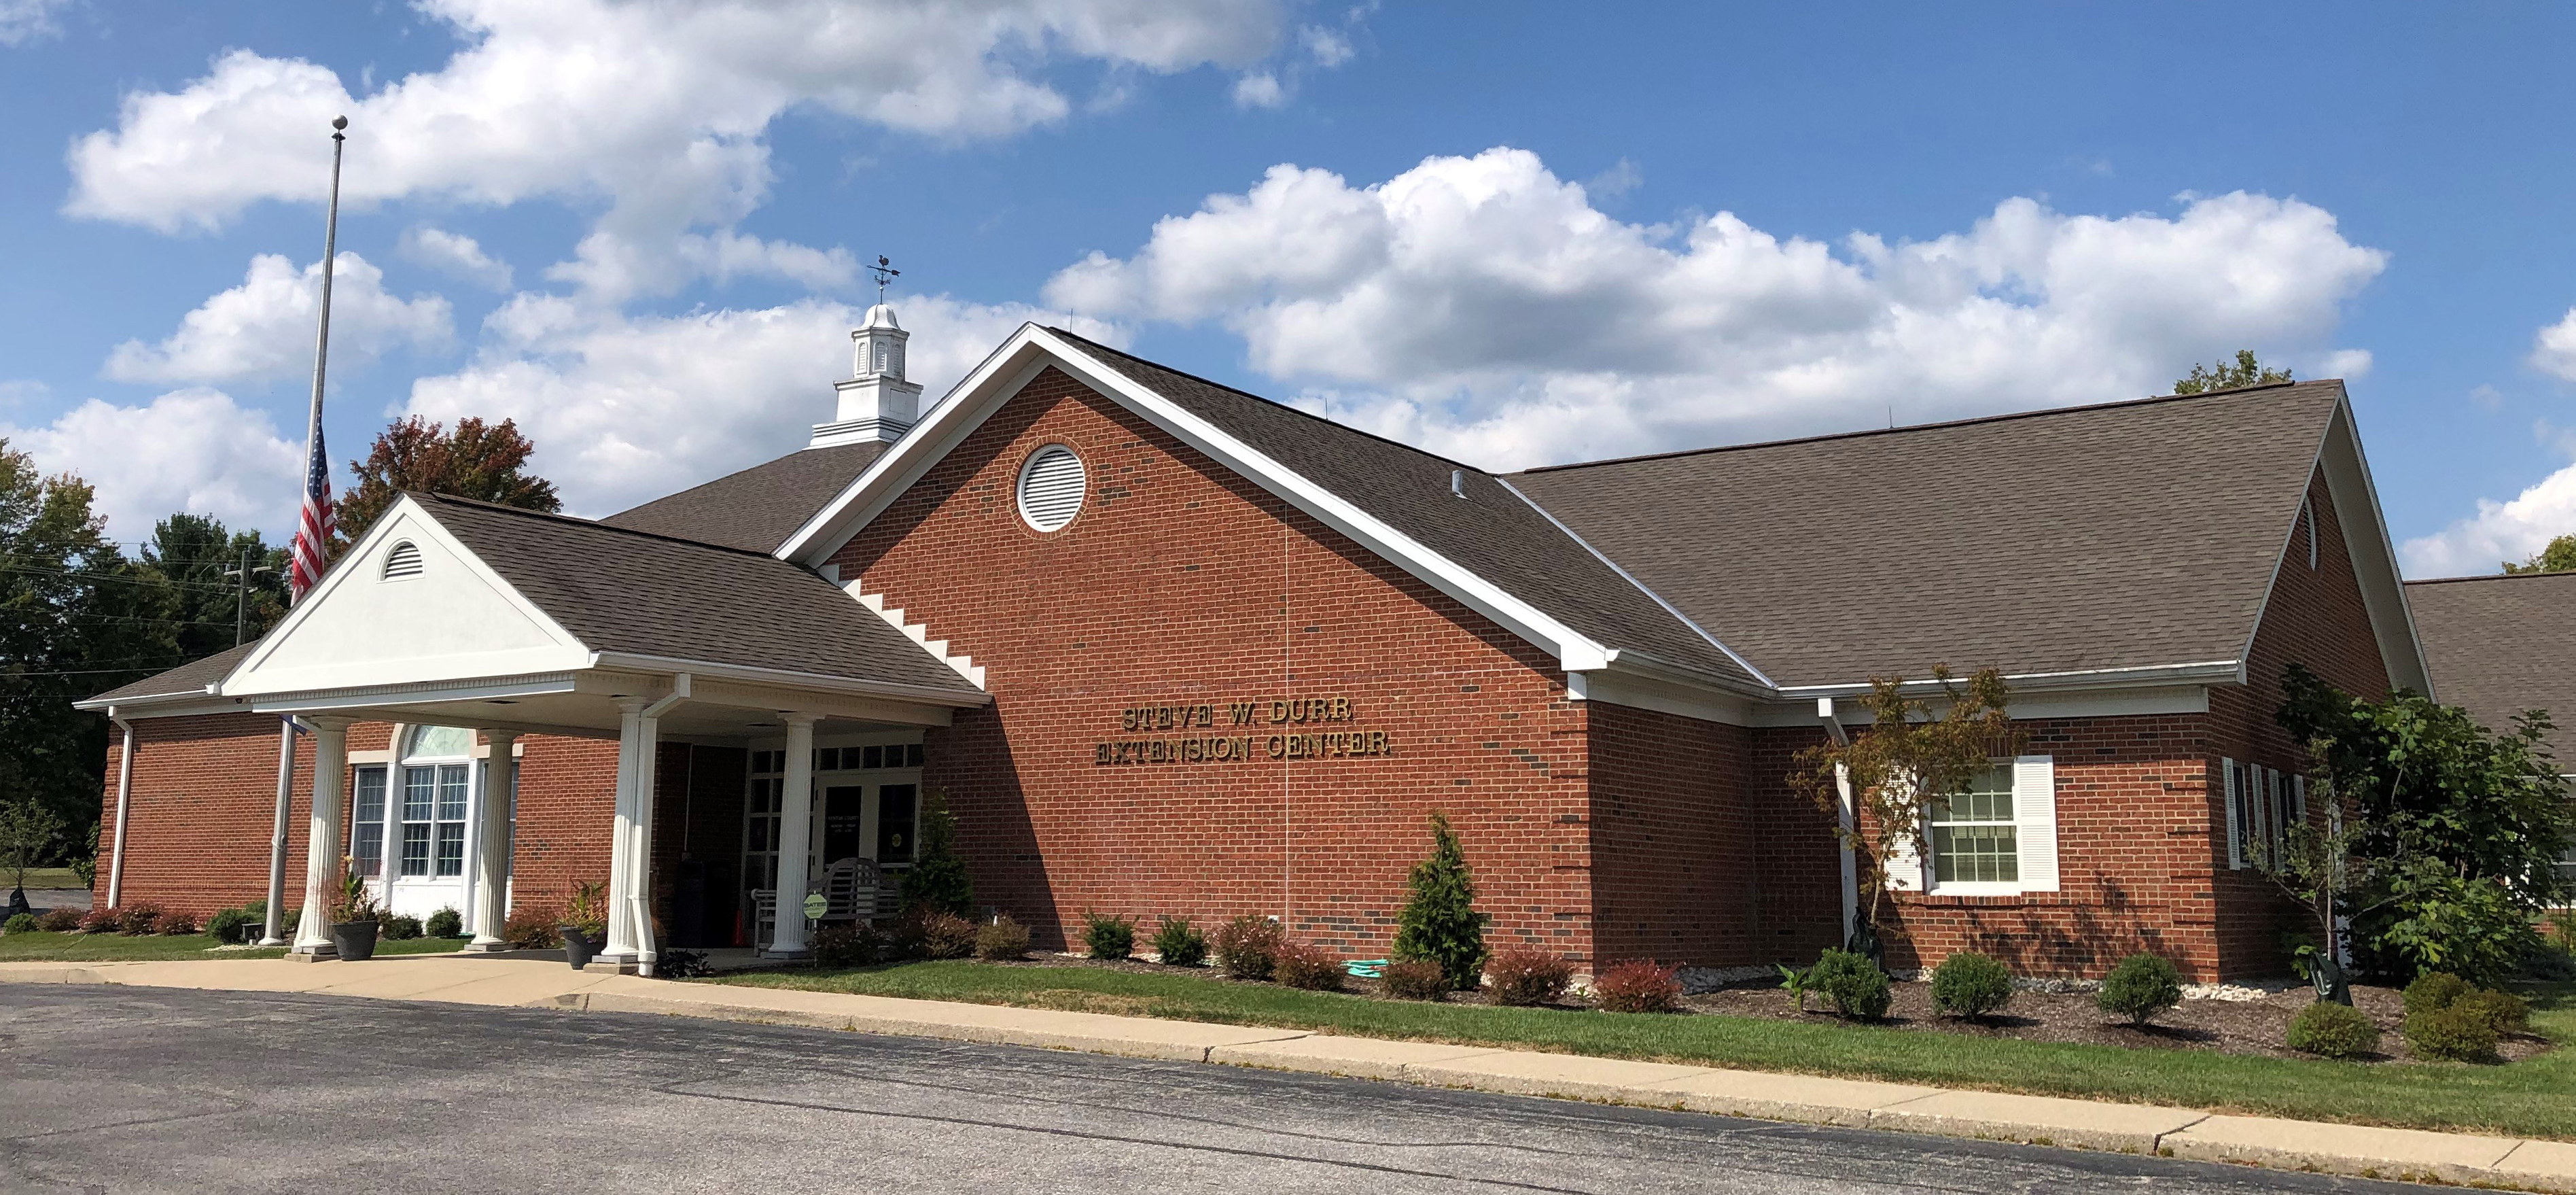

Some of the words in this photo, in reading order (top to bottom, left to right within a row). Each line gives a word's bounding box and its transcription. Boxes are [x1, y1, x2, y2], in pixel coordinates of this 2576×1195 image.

[1122, 703, 1212, 729] STEVE
[1227, 702, 1257, 727] W.
[1269, 696, 1352, 723] DURR
[1095, 736, 1252, 763] EXTENSION
[1266, 730, 1390, 757] CENTER
